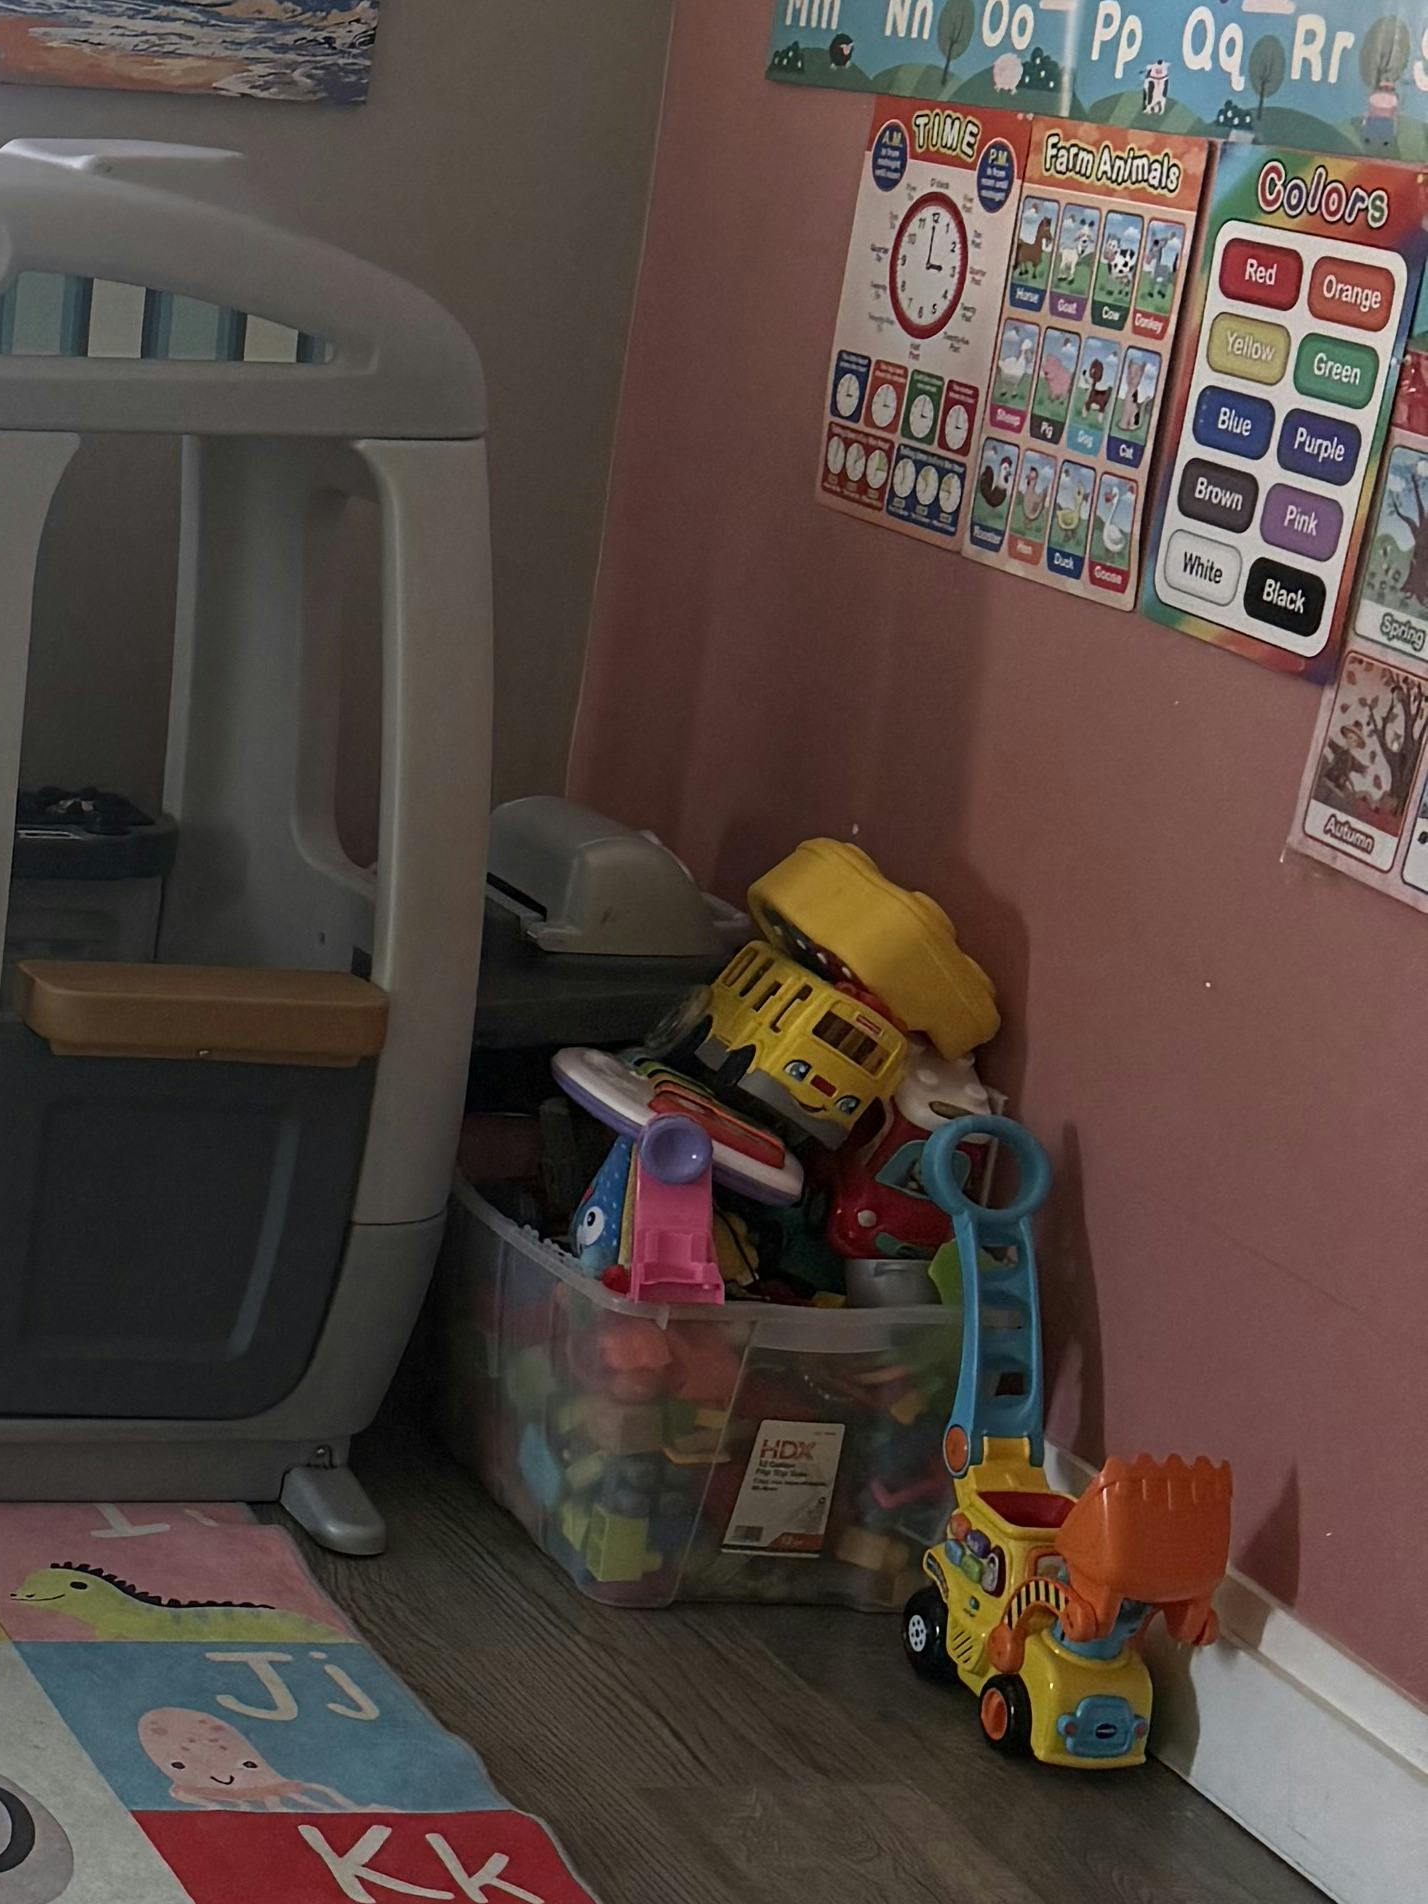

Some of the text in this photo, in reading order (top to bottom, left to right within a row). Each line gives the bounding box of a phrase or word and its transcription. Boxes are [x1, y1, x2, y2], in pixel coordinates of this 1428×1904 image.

[1091, 0, 1142, 79] Pp
[1181, 6, 1245, 92] Qq
[1291, 13, 1355, 84] Rr
[913, 113, 979, 157] TIME
[1045, 133, 1180, 193] Farm Animals
[1258, 159, 1388, 228] Colors
[1245, 259, 1276, 286] Red
[1058, 300, 1077, 315] Goat
[1322, 274, 1382, 313] Orange
[1102, 306, 1120, 321] Cow
[1225, 330, 1276, 362] Yellow
[1313, 352, 1361, 385] Green
[1040, 421, 1054, 439] Pig
[1217, 407, 1253, 436] Blue
[1294, 427, 1345, 462] Purple
[1194, 476, 1243, 511] Brown
[1283, 505, 1319, 536] Pink
[1054, 554, 1074, 571] Duck
[1182, 551, 1223, 584] White
[1262, 578, 1305, 614] Black
[1381, 612, 1426, 651] Spring
[1324, 814, 1374, 854] Autumn
[760, 1439, 816, 1460] HDX
[205, 1650, 380, 1724] Jj
[297, 1824, 546, 1904] Kk
